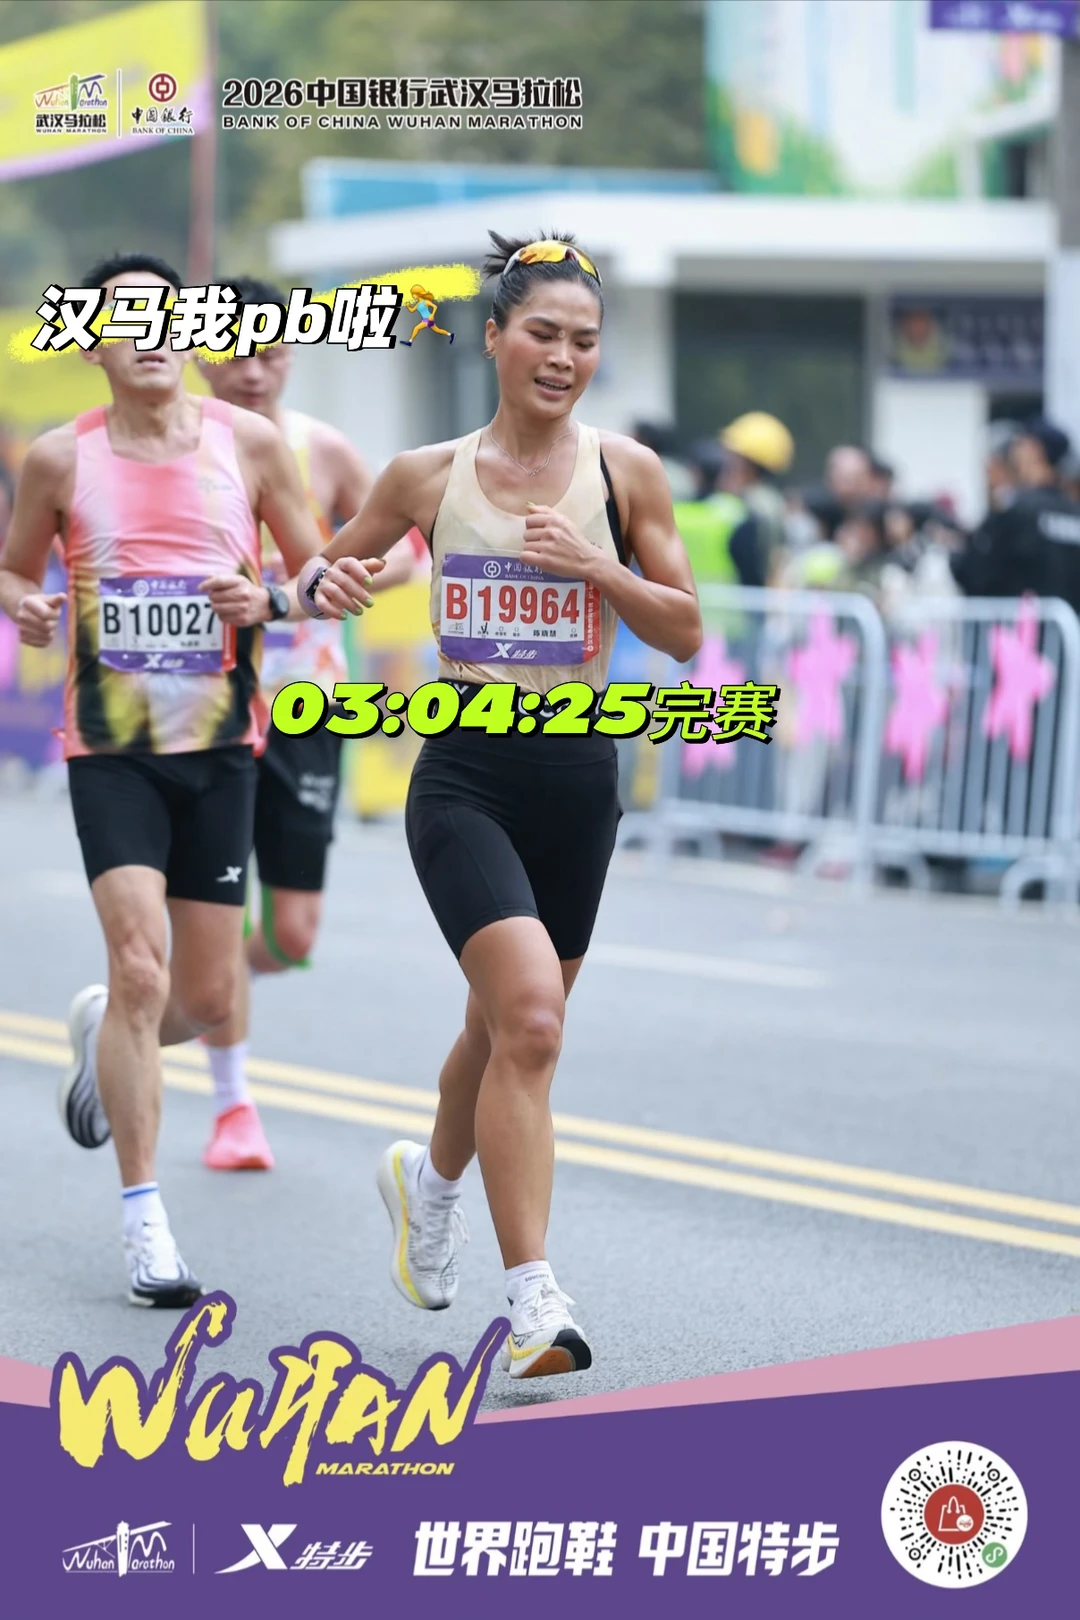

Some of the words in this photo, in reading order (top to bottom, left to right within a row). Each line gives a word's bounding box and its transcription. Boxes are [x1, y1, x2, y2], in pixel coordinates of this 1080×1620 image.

[104, 602, 121, 634] B
[129, 603, 216, 636] 10027
[446, 583, 468, 620] B
[477, 585, 580, 625] 19964
